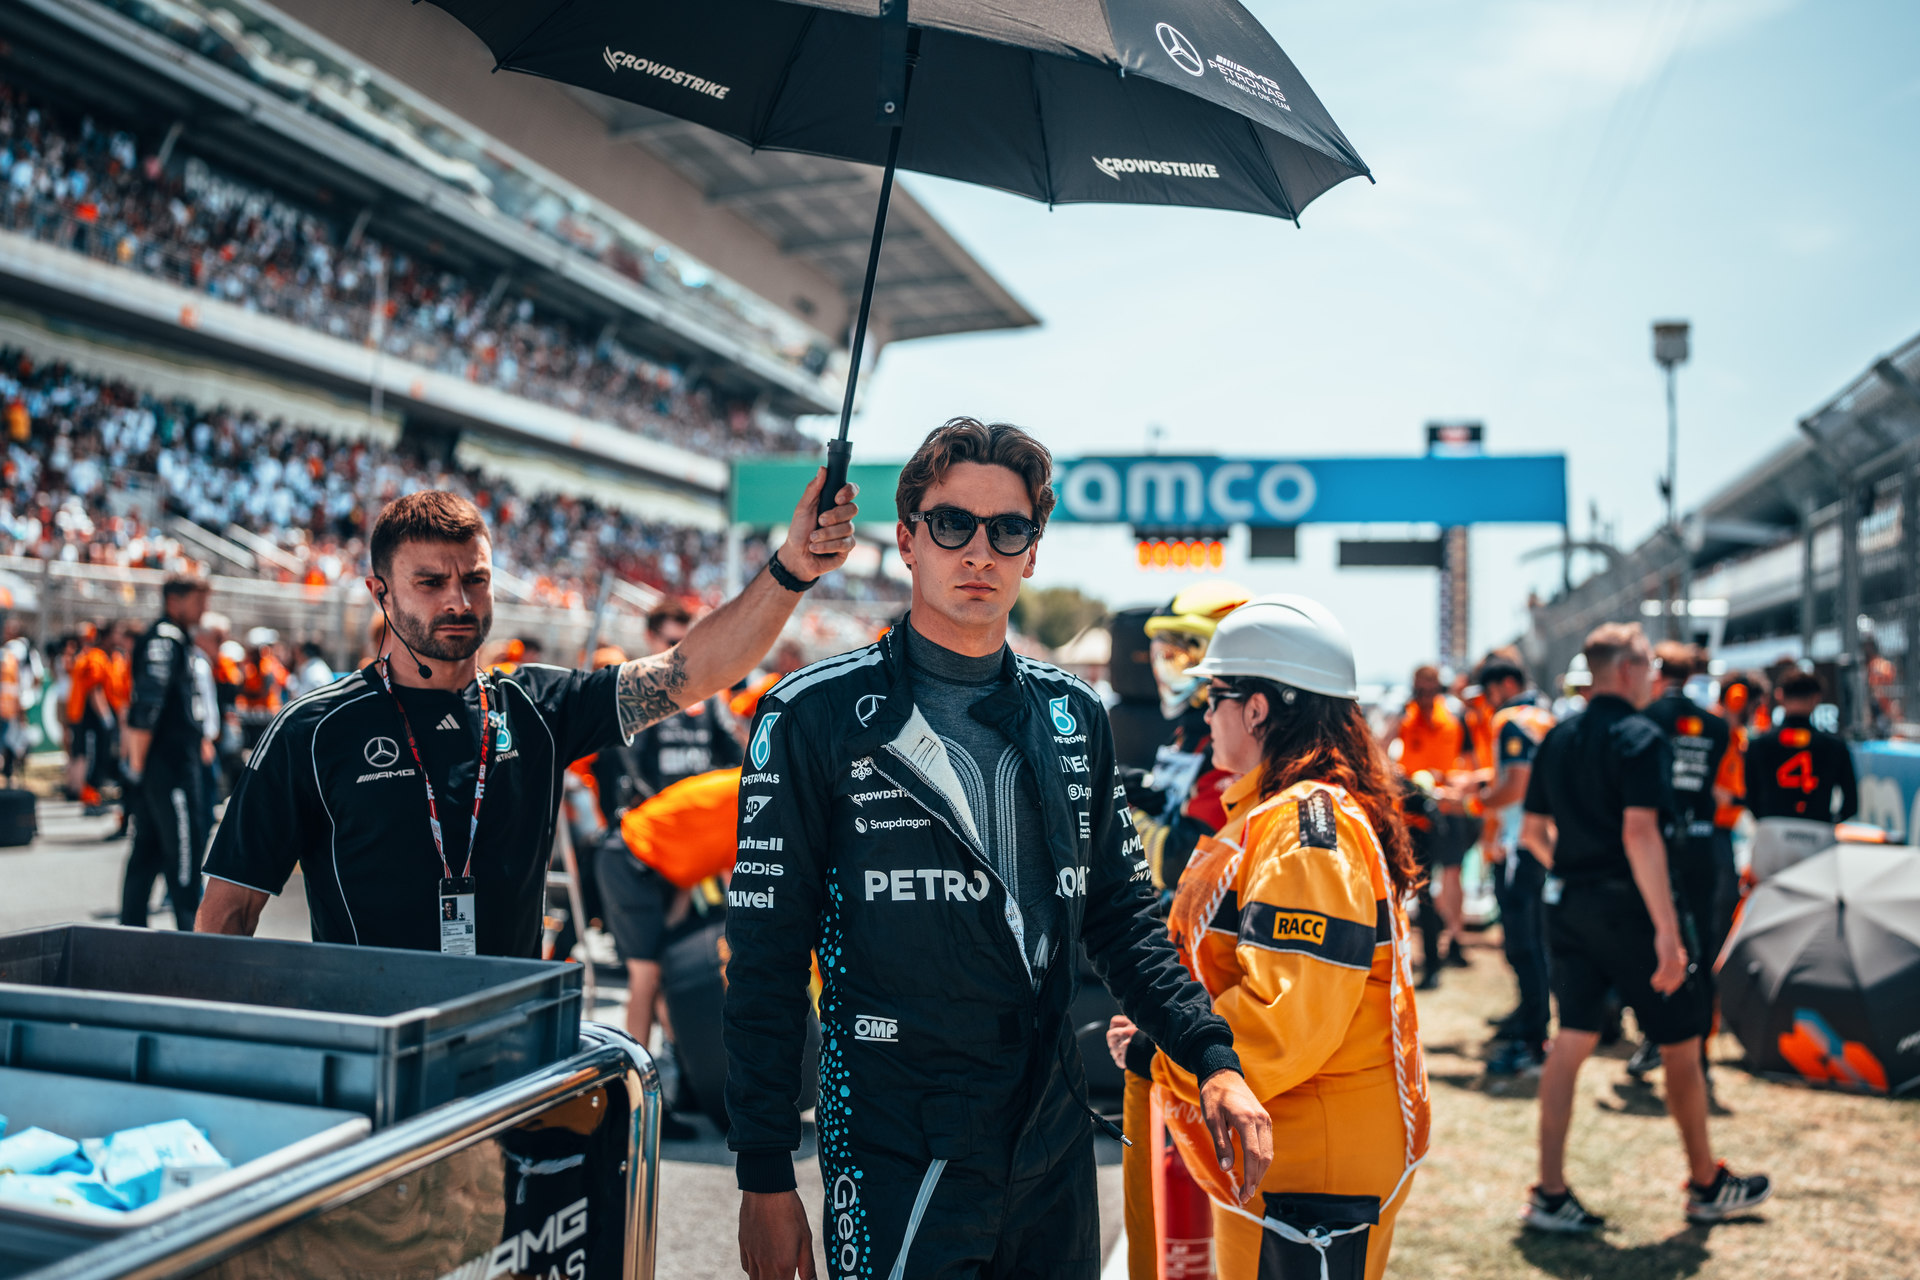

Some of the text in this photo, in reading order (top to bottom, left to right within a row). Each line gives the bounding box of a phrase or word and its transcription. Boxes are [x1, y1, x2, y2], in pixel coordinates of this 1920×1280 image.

[611, 50, 730, 99] CROWDSTRIKE
[1207, 59, 1286, 101] PETRONAS
[1101, 157, 1220, 178] CROWDSTRIKE
[742, 773, 780, 786] PETRONAS
[1776, 750, 1819, 793] 4
[853, 789, 908, 802] CROWDST
[870, 818, 931, 831] Snapdragon
[1277, 917, 1324, 939] RACC
[854, 1019, 898, 1039] OMP
[833, 1174, 859, 1280] Geo
